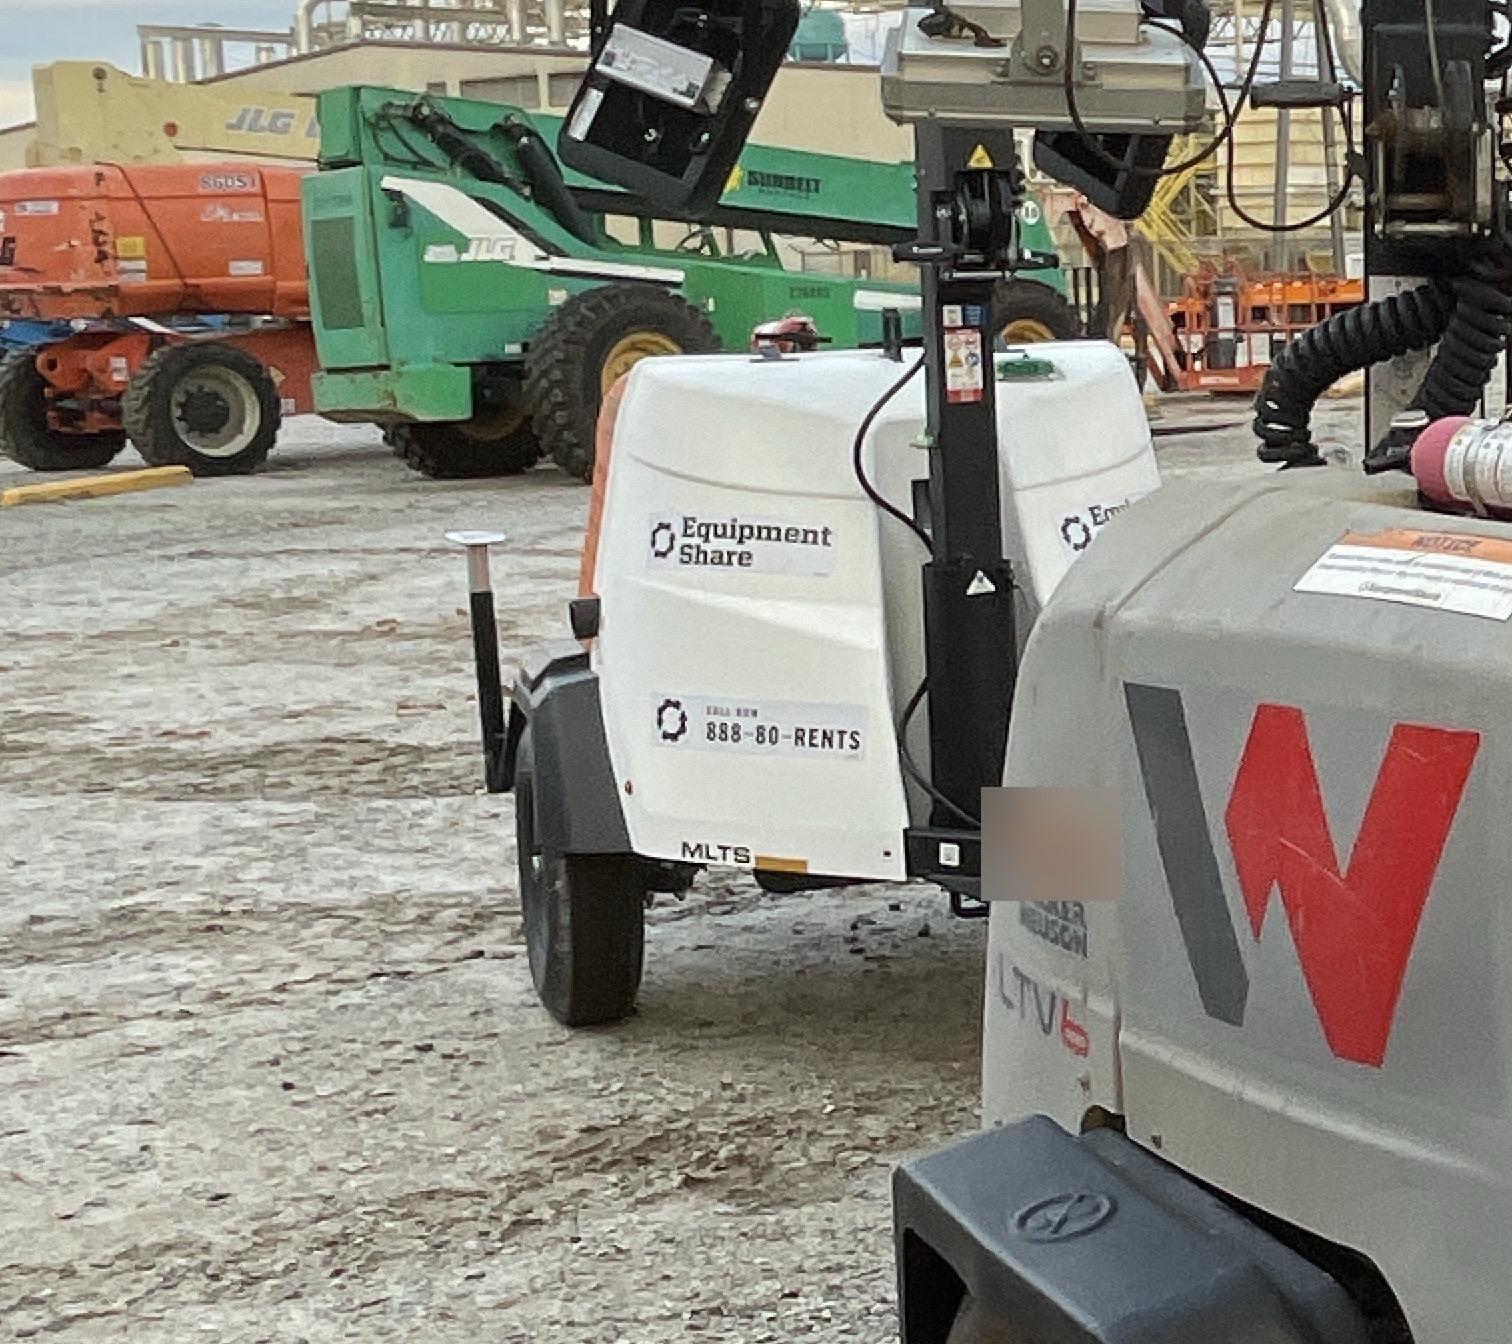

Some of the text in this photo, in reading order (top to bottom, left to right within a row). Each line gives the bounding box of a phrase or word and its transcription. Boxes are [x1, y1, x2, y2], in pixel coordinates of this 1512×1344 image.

[225, 108, 295, 135] JLG
[461, 236, 516, 260] JLG
[682, 516, 832, 547] Equipment
[679, 543, 753, 567] Share
[706, 721, 861, 750] 888-80-RENTS
[681, 841, 750, 864] MLTS
